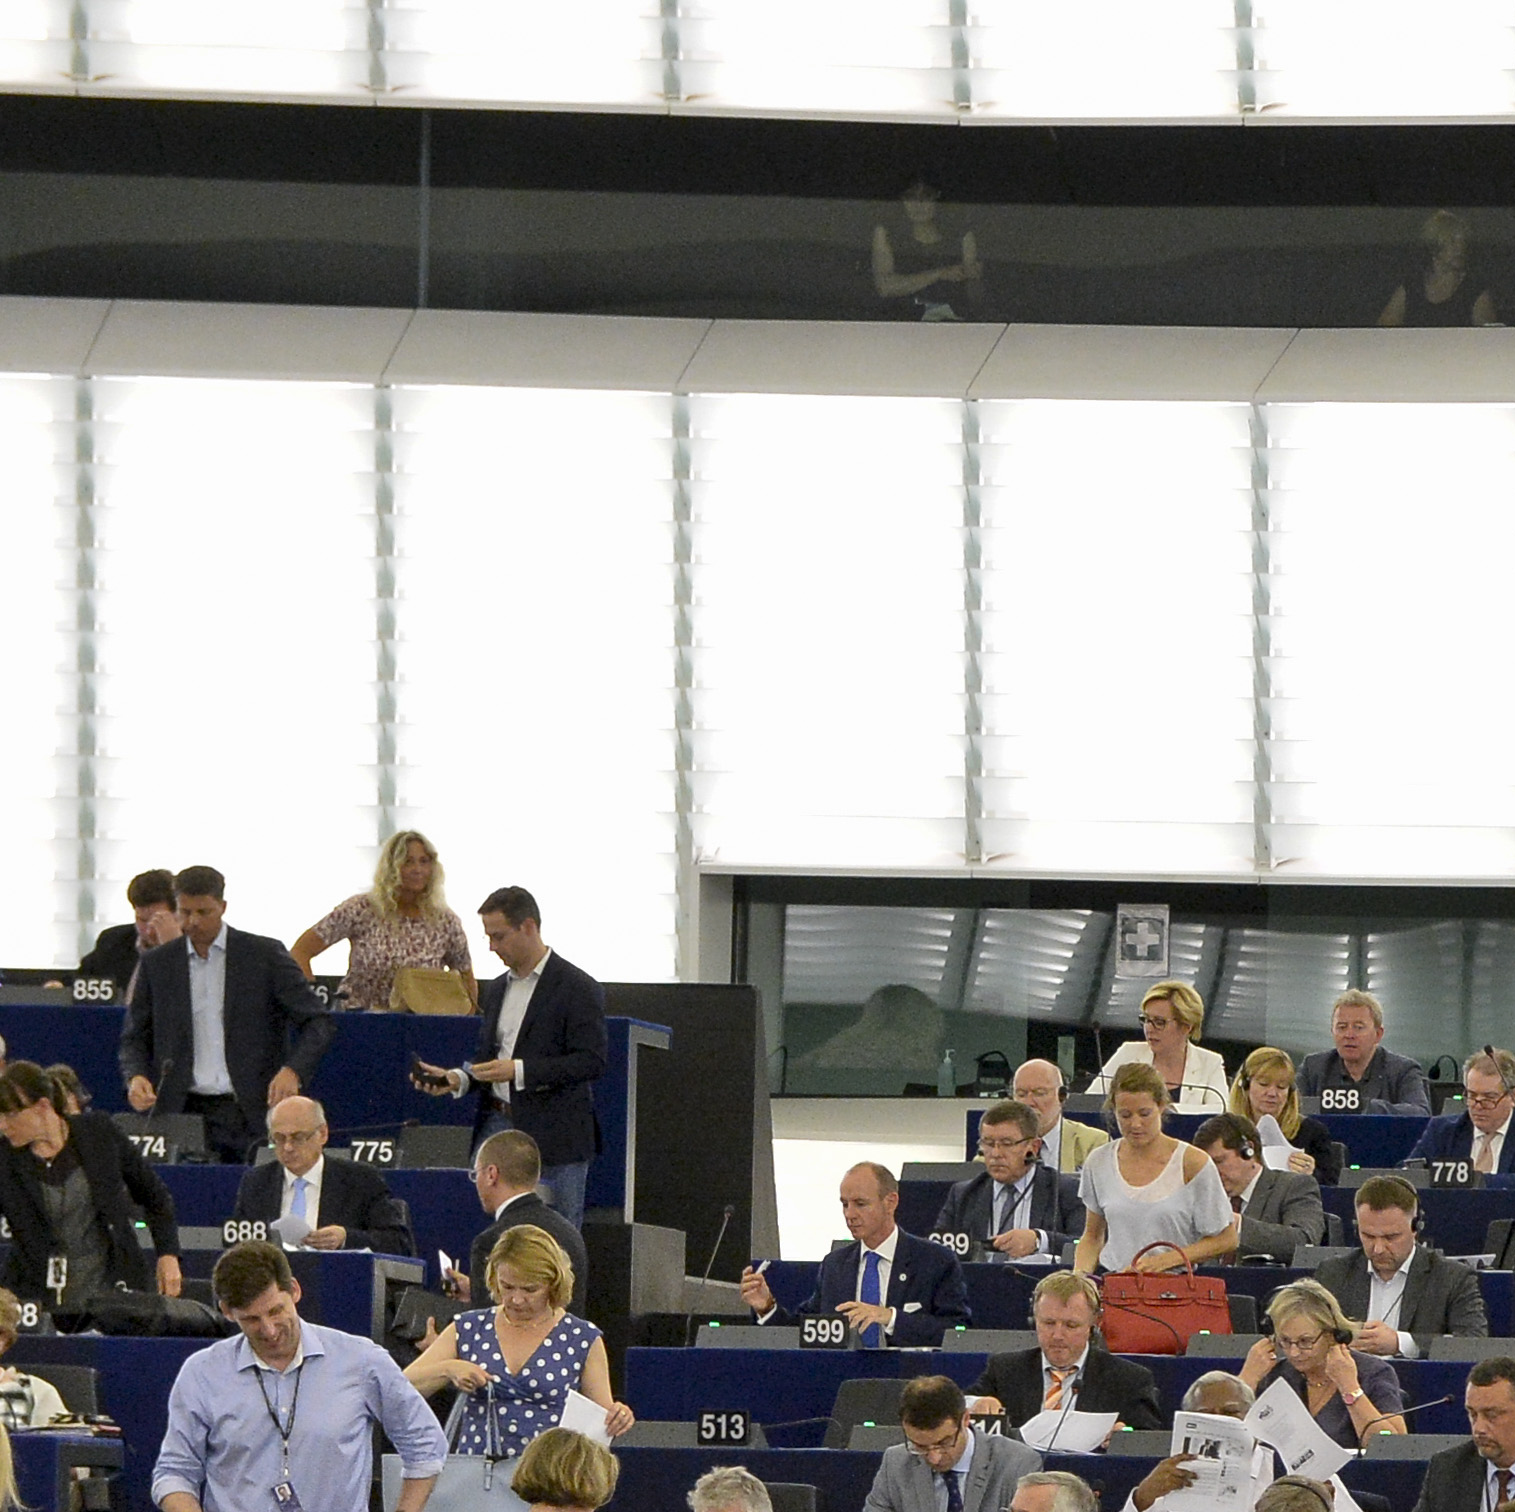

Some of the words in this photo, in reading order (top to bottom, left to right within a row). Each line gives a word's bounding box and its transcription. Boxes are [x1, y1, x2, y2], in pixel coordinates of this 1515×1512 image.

[73, 980, 113, 1000] 855
[1321, 1089, 1360, 1110] 858
[351, 1140, 393, 1161] 775
[1432, 1162, 1469, 1183] 778
[223, 1220, 267, 1242] 688
[803, 1319, 845, 1343] 599
[701, 1413, 746, 1440] 513
